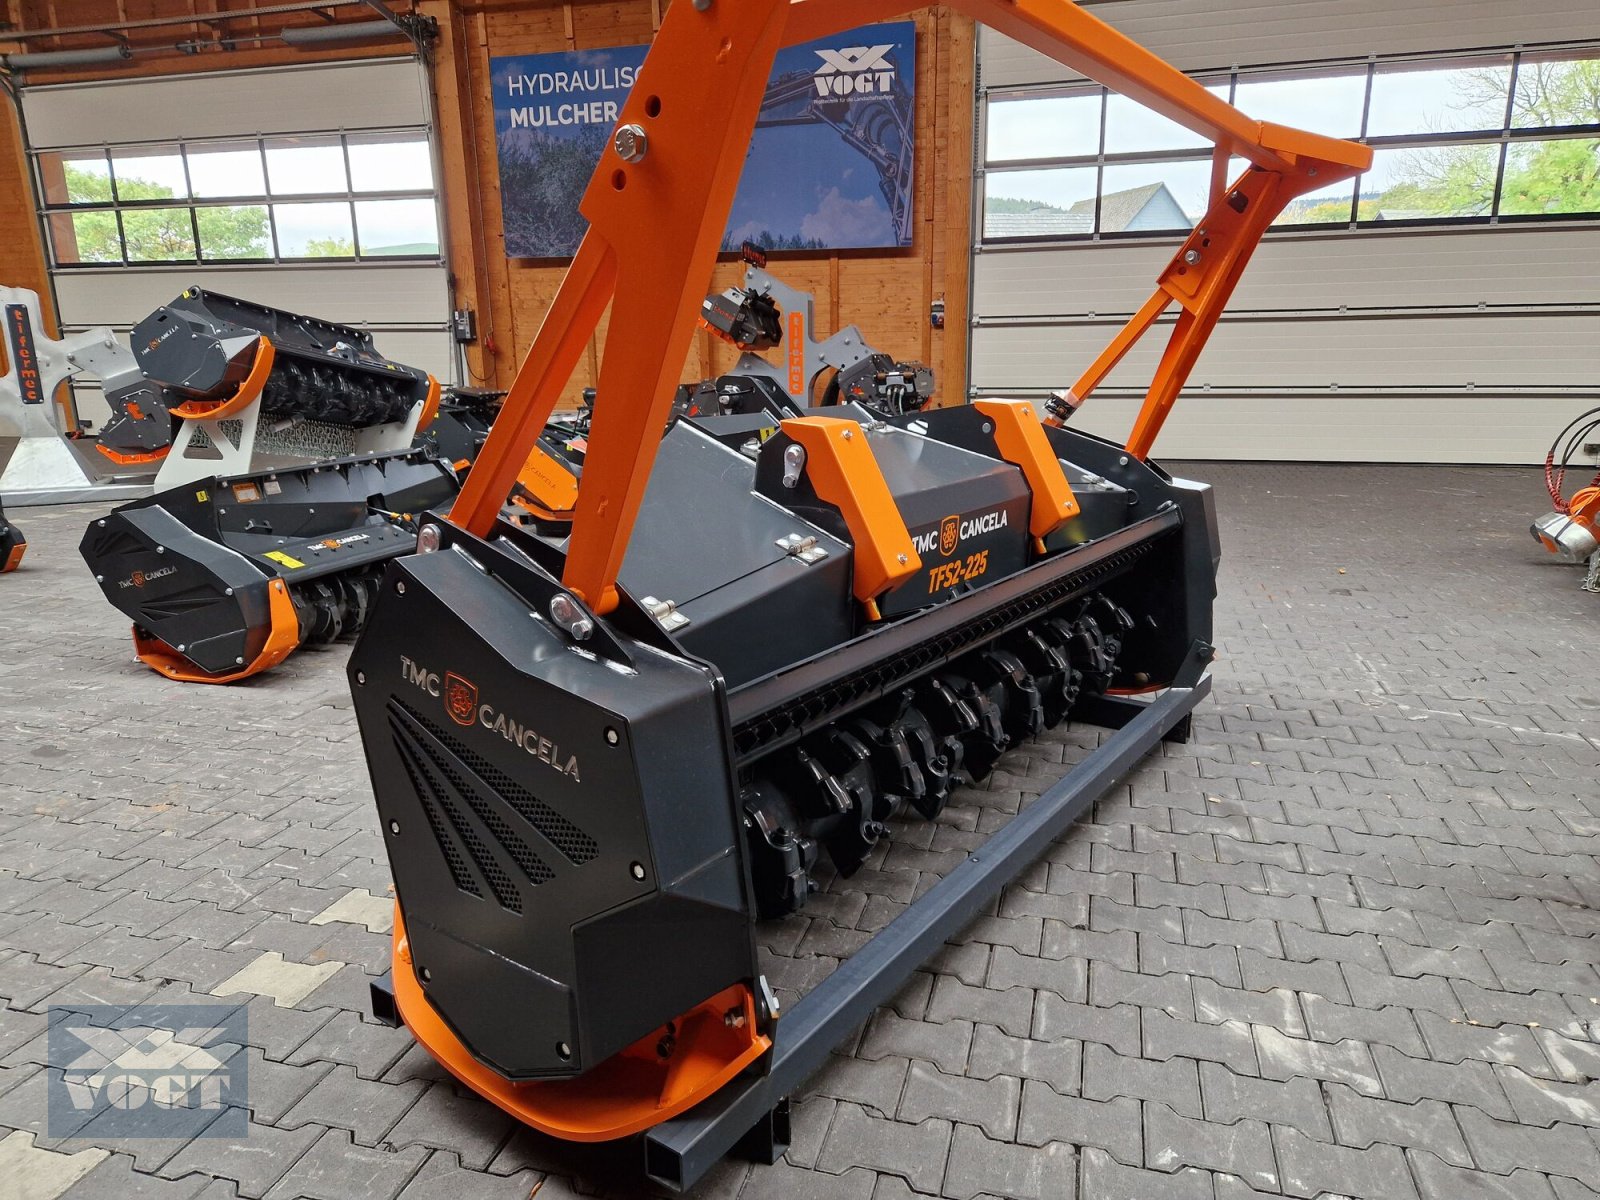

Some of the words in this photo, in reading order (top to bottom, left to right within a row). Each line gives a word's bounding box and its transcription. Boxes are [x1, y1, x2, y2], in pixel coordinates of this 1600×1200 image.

[813, 71, 895, 97] VOGT
[510, 101, 619, 128] MULCHER
[911, 530, 939, 554] TMC
[960, 509, 1008, 540] CANCELA
[144, 565, 178, 581] CANCELA
[928, 549, 989, 594] TFS2-225
[400, 655, 441, 698] TMC
[478, 704, 581, 783] CANCELA
